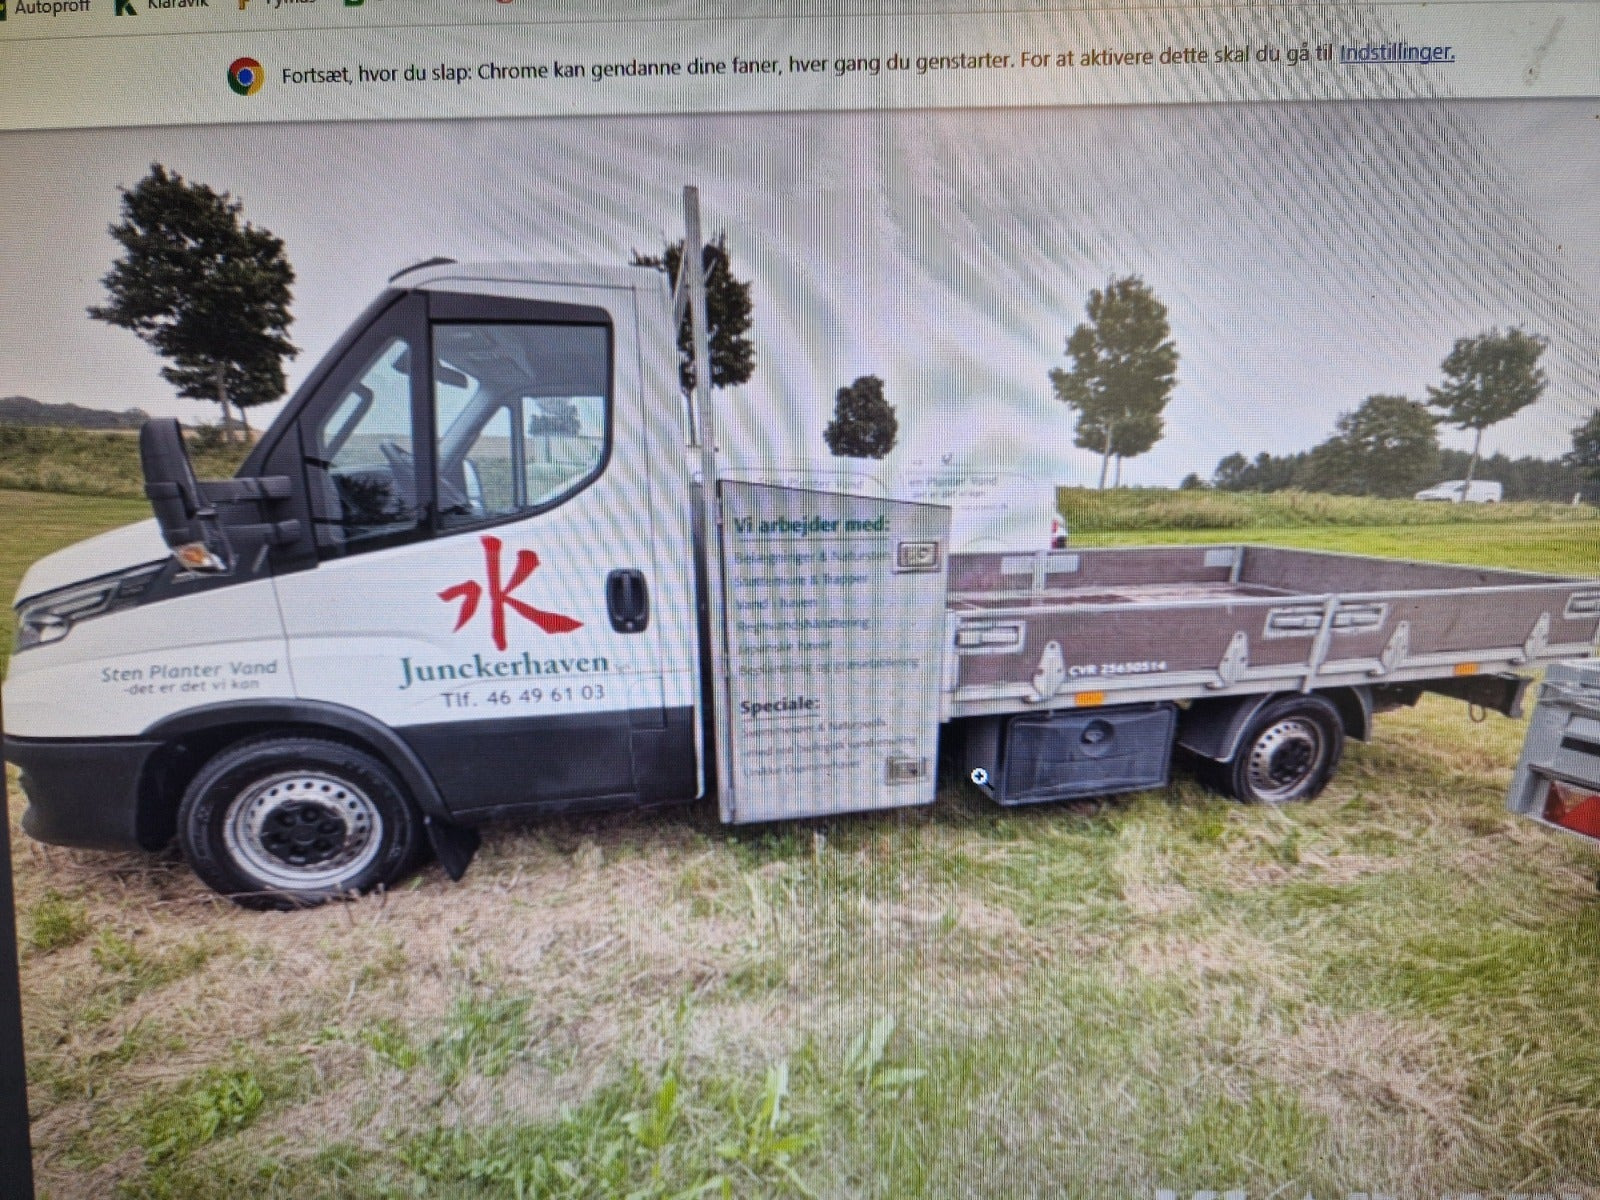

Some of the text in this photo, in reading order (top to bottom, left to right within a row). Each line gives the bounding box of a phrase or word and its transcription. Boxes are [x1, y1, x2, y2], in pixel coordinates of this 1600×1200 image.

[282, 41, 1456, 85] Fortsæt, hvor du slap: Chrome kan gendanne dine faner, hver gang du genstarter. For at aktivere dette skal du gå til Indstillinger.
[734, 514, 891, 537] Vi arbejder med:
[101, 659, 278, 683] Sten Planter Vand
[398, 650, 609, 690] Junckerhaven
[124, 678, 260, 696] -det er det vi kan
[441, 683, 606, 708] Tlf. 46 49 61 03
[740, 695, 821, 717] Speciale:
